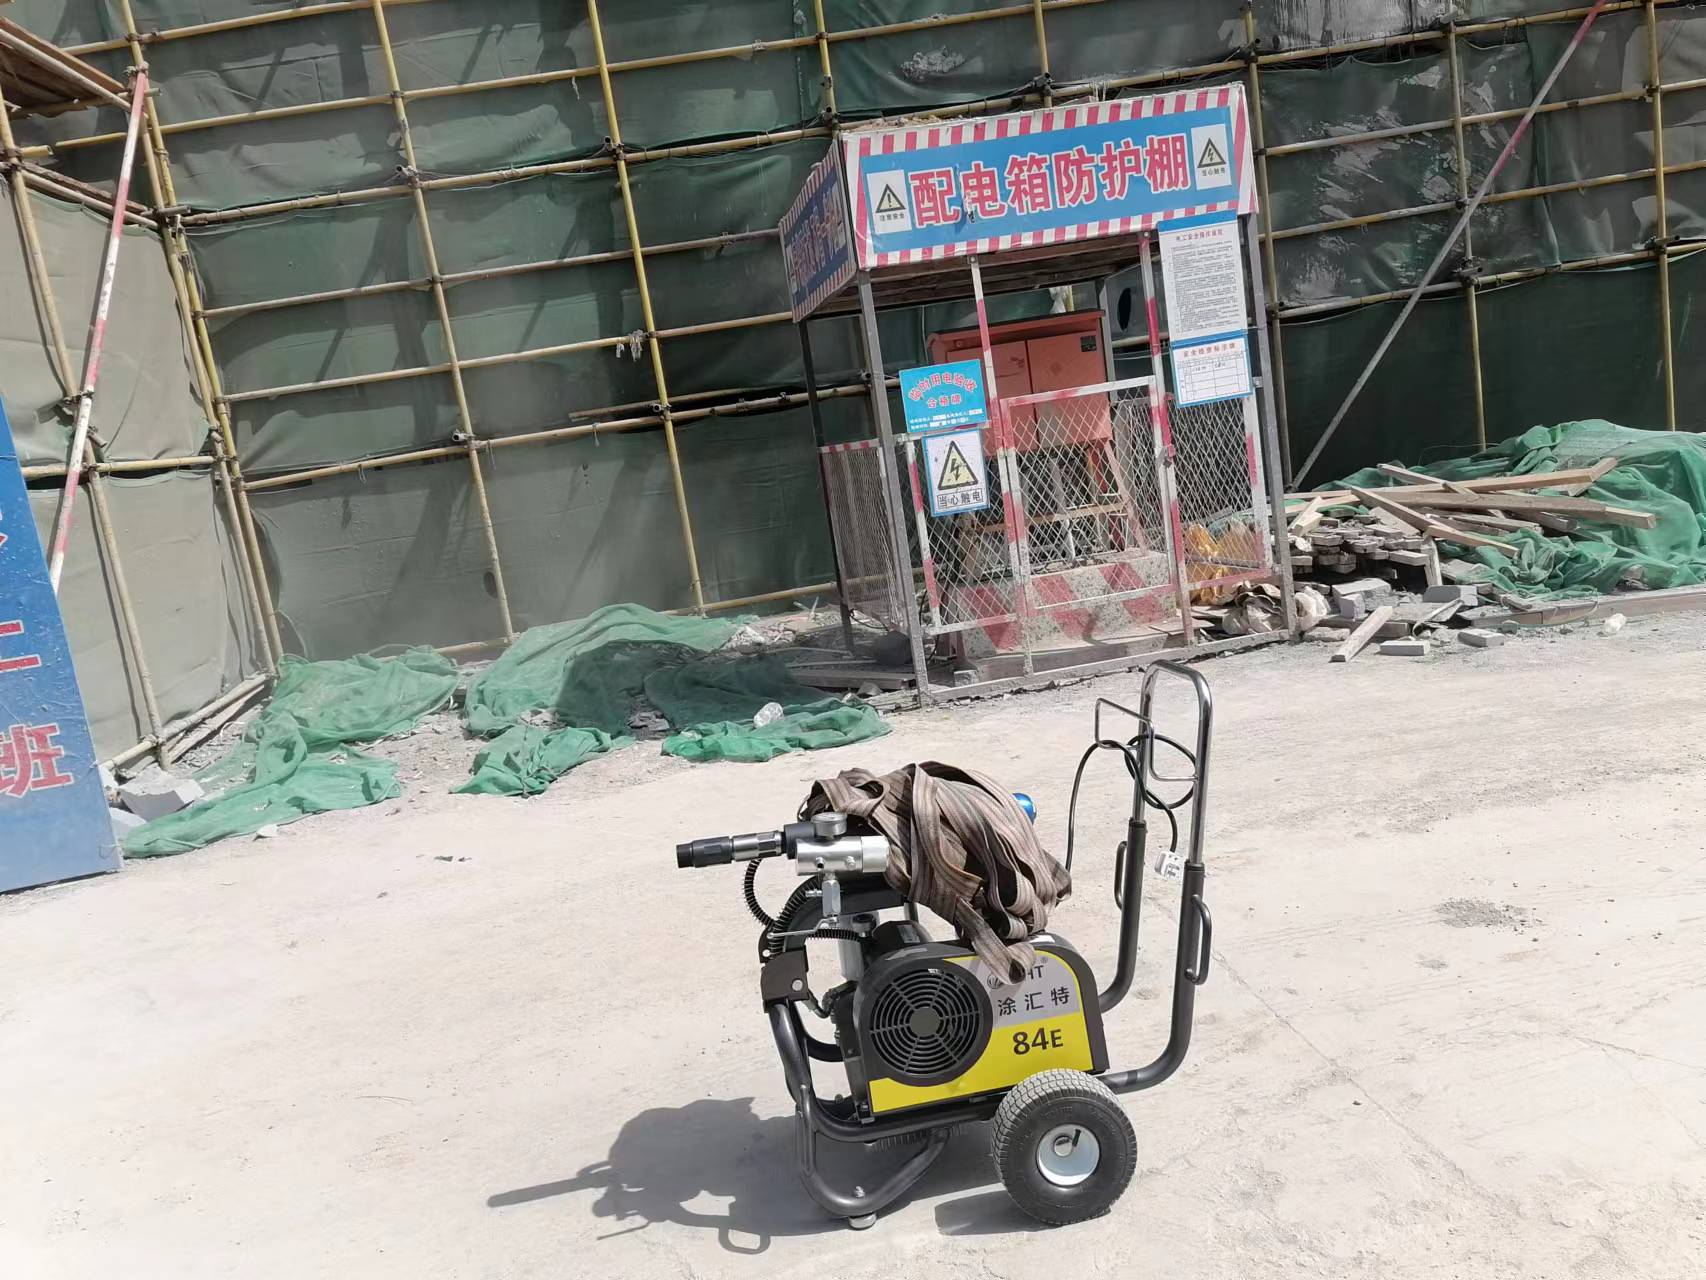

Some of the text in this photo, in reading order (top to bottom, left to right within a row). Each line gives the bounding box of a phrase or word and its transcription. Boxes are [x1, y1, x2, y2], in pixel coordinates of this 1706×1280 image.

[909, 134, 1191, 228] 配电箱防护棚
[938, 491, 983, 508] 当心触电
[998, 986, 1070, 1016] 涂汇特
[1013, 1027, 1063, 1055] 84E
